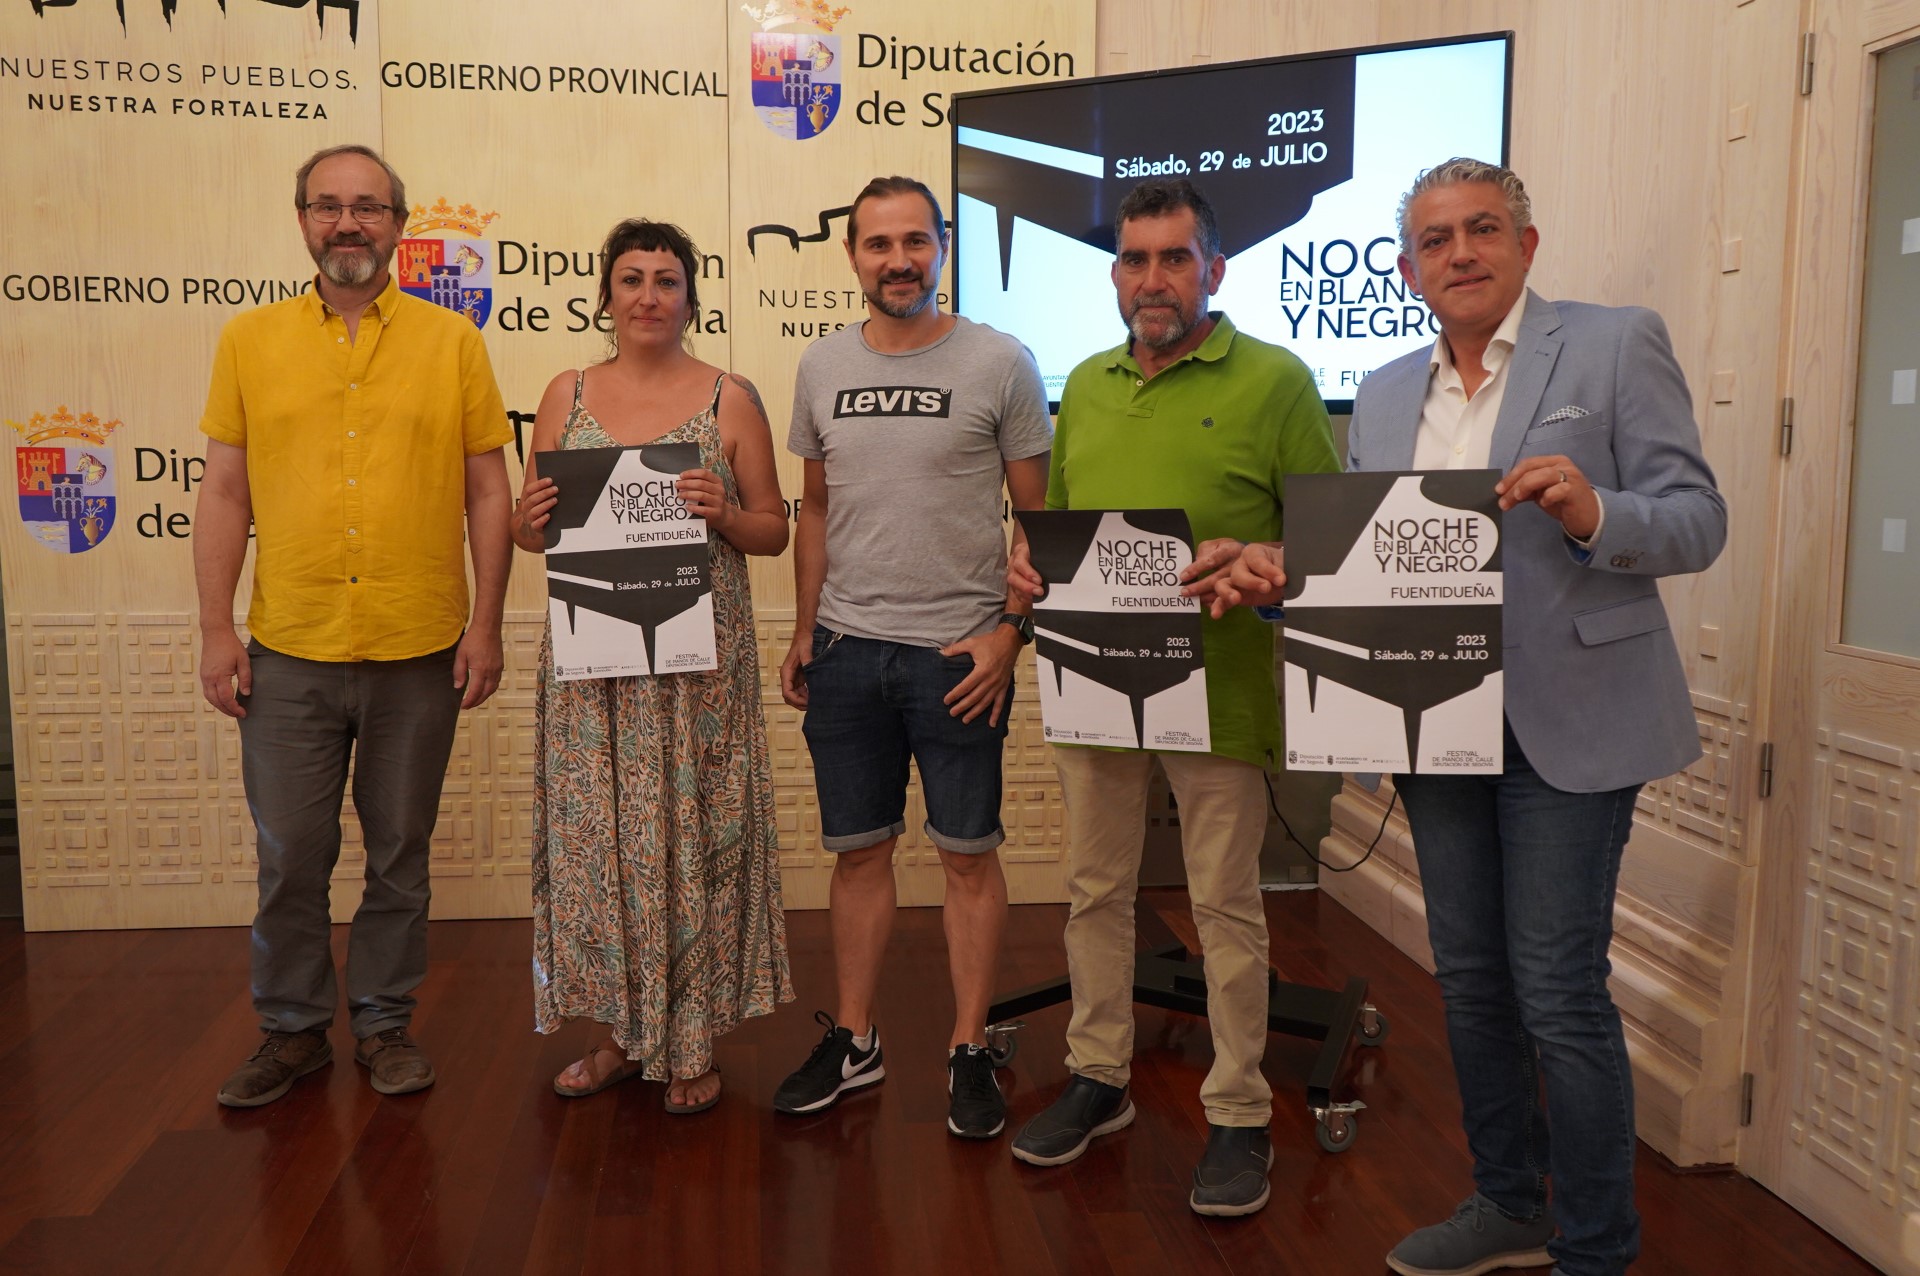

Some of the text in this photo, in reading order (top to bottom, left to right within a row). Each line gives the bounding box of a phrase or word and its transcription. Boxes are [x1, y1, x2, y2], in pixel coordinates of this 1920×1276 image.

[857, 33, 1075, 80] Diputación
[0, 57, 358, 90] NUESTROS PUEBLOS,
[380, 60, 728, 97] GOBIERNO PROVINCIAL
[27, 93, 328, 120] NUESTRA FORTALEZA
[856, 90, 906, 126] de
[1267, 108, 1324, 136] 2023
[1115, 141, 1328, 179] Sábado, 29 de JULIO
[1281, 236, 1396, 280] NOC
[2, 274, 170, 304] GOBIERNO
[759, 289, 868, 309] NUEST
[1280, 276, 1423, 306] EN BLAN
[497, 296, 550, 332] de
[1281, 303, 1311, 340] Y
[609, 480, 681, 500] NOCH
[610, 496, 687, 510] EN BLANCO
[136, 502, 191, 538] de
[612, 507, 688, 524] Y NEGRO
[625, 527, 702, 543] FUENTIDUEÑA
[1374, 517, 1479, 541] NOCHE
[1096, 540, 1177, 559] NOCHE
[1374, 538, 1478, 555] EN BLANCO
[676, 565, 698, 576] 2023
[1098, 557, 1177, 571] EN BLANCO
[1374, 553, 1478, 573] Y NEGRO
[651, 579, 662, 589] 29
[674, 577, 701, 586] JULIO
[1099, 568, 1178, 586] Y NEGRO
[1112, 594, 1195, 607] FUENTIDUEÑA
[1391, 582, 1496, 599] FUENTIDUEÑA
[1166, 637, 1190, 647] 2023
[1456, 634, 1487, 646] 2023
[1103, 648, 1136, 658] Sábado,
[1139, 649, 1150, 657] 29
[1165, 649, 1193, 659] JULIO
[1374, 649, 1489, 661] Sábado, 29 de JULIO
